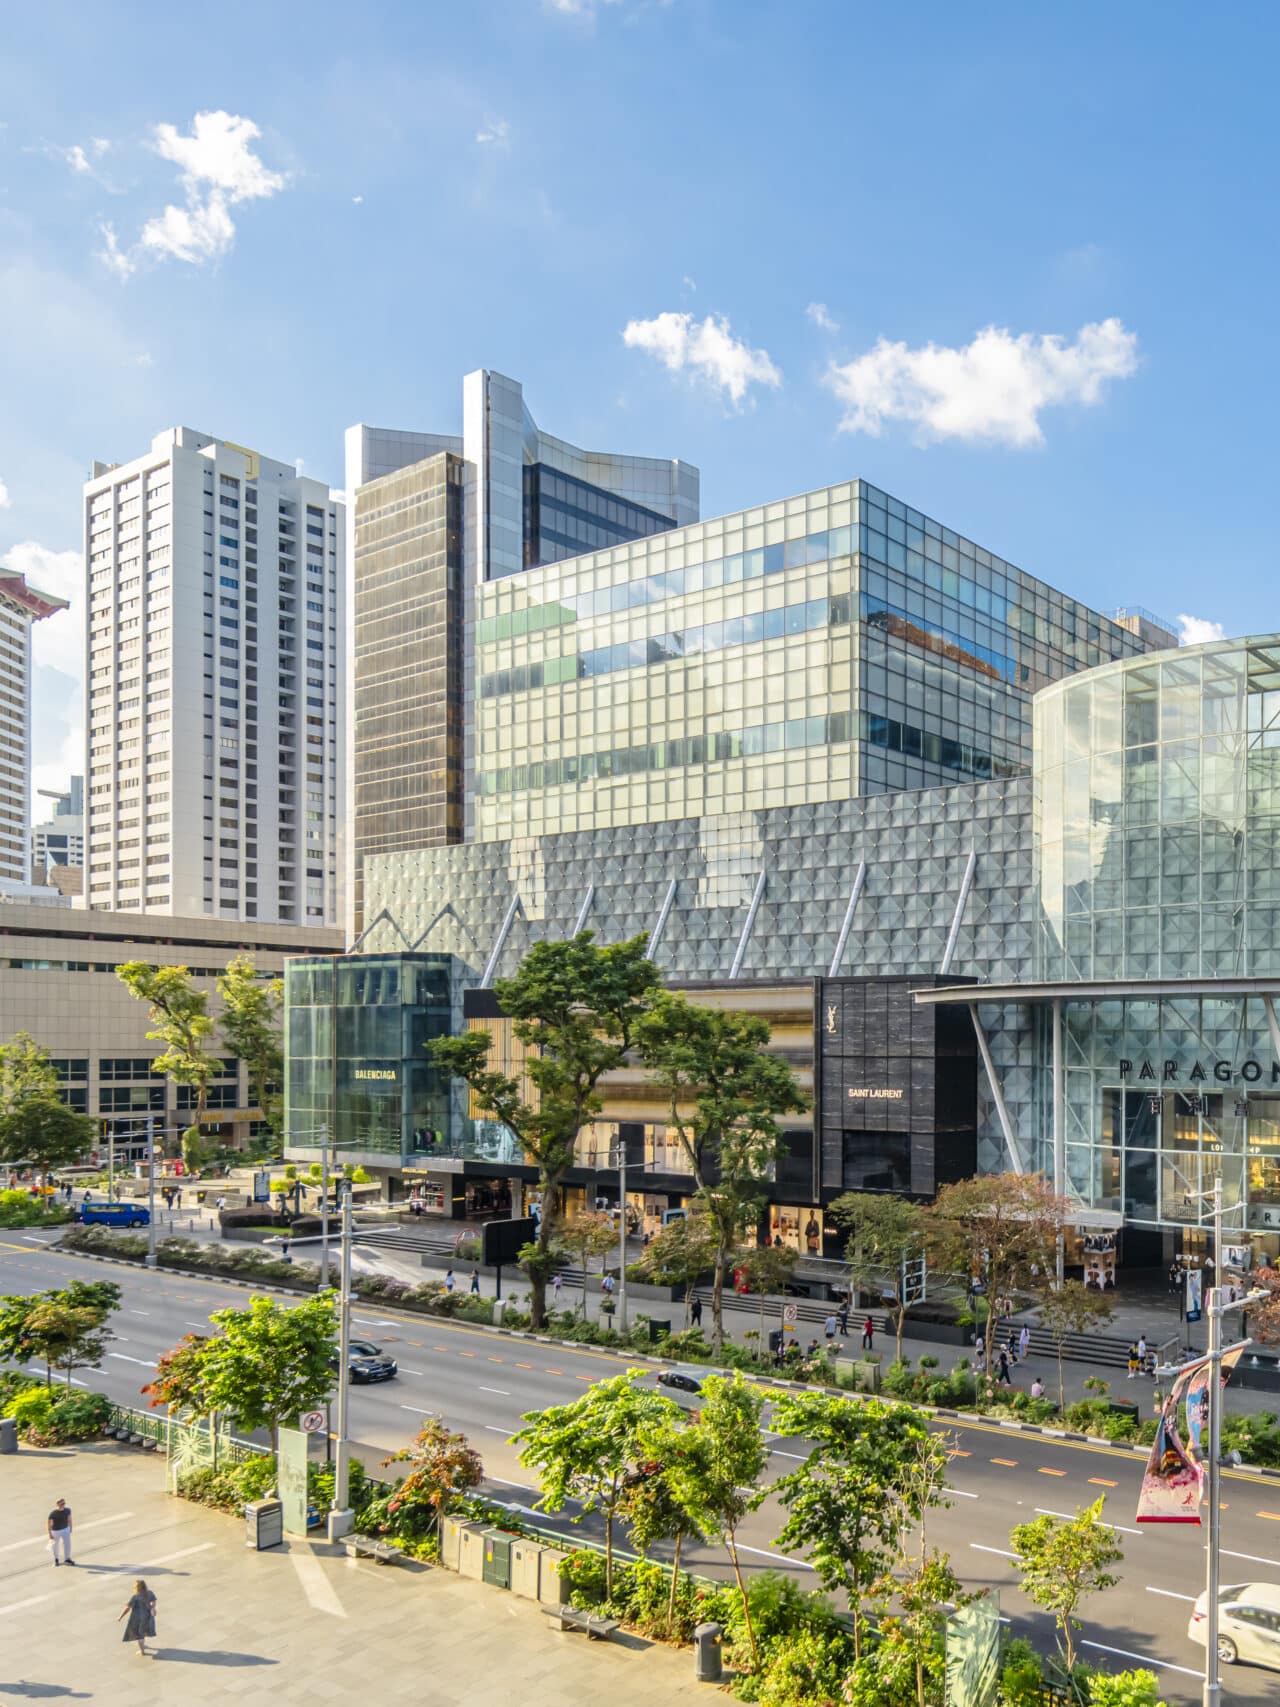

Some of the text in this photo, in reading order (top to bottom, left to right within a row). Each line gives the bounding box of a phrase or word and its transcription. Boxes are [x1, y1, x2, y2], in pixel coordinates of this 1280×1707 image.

[355, 1069, 396, 1080] BALENCIAGA
[848, 1088, 903, 1099] SAINT LAURENT
